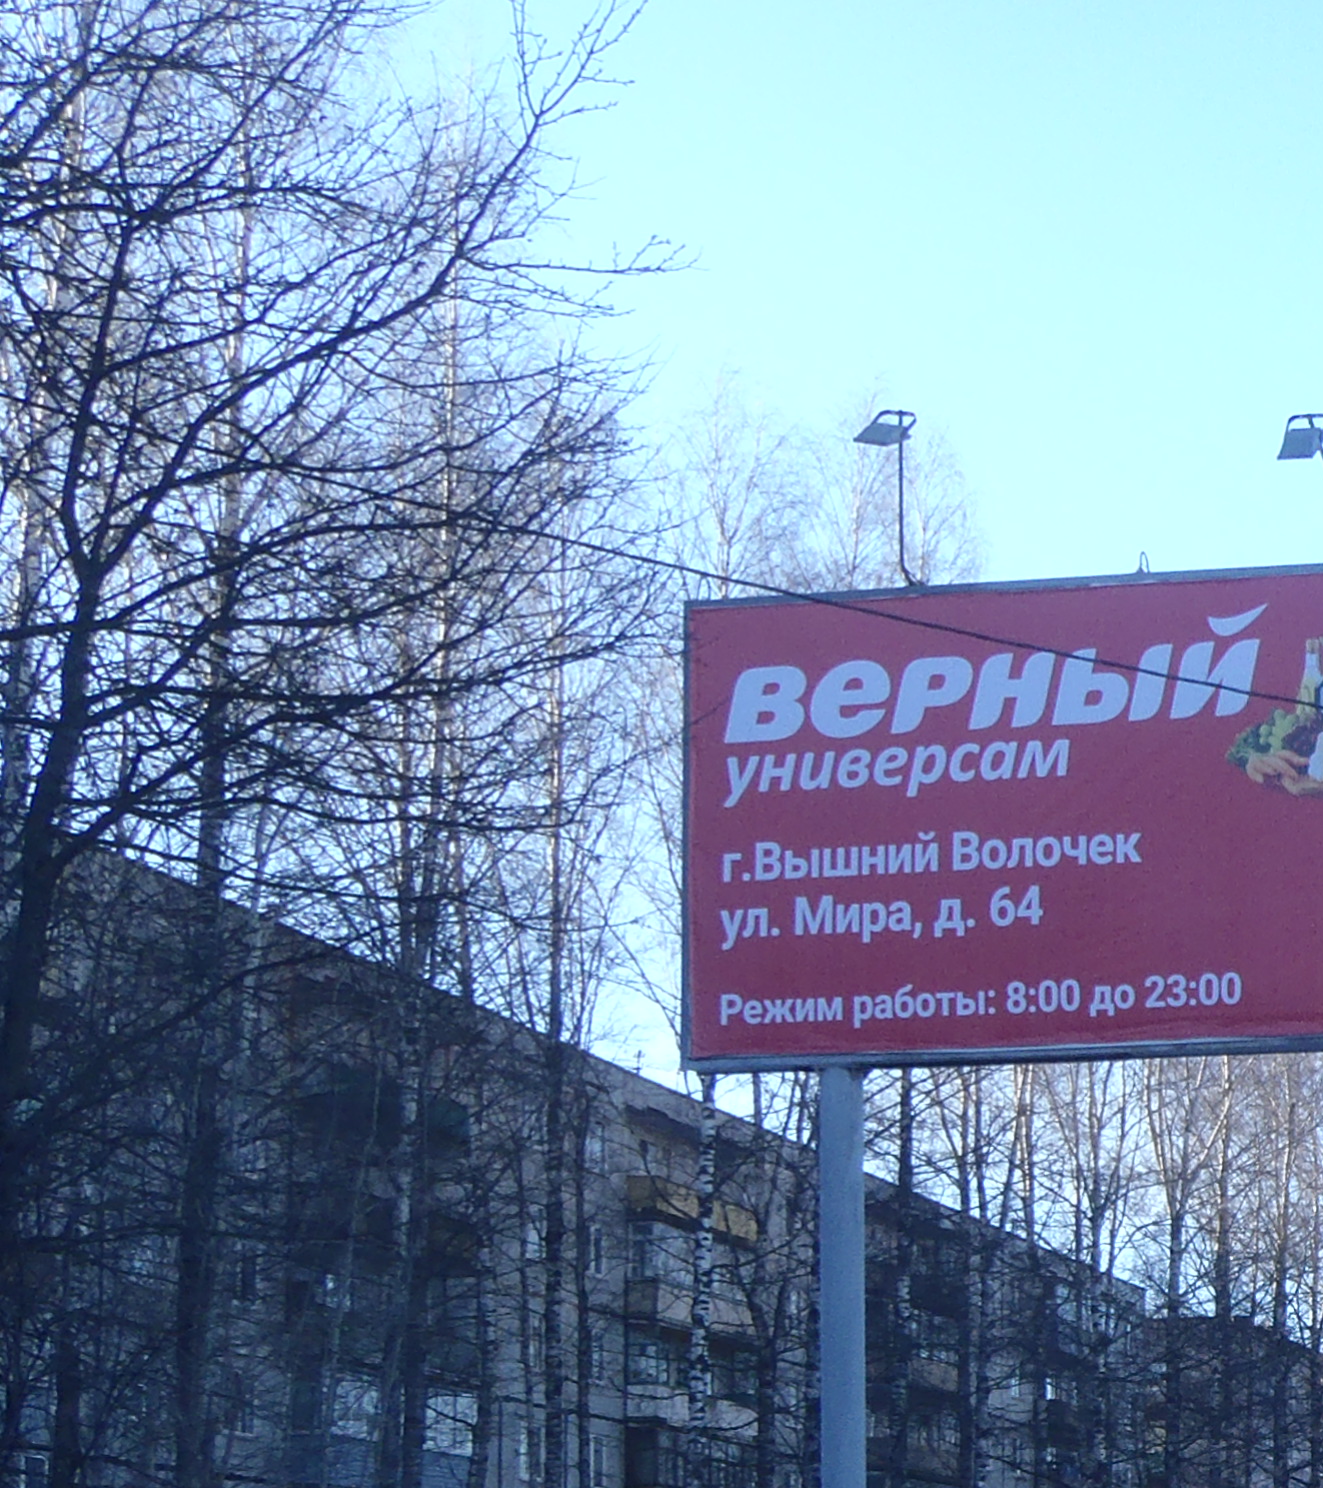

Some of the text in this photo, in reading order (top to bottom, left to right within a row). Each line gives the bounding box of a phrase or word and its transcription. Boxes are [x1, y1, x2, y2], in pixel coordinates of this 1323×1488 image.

[722, 738, 1070, 808] универсам
[721, 830, 1142, 883] г.Вышний Волочек
[720, 885, 1044, 950] ул. Мира, д. 64
[720, 972, 1242, 1028] Режим работы: 8:00 до 23:00
